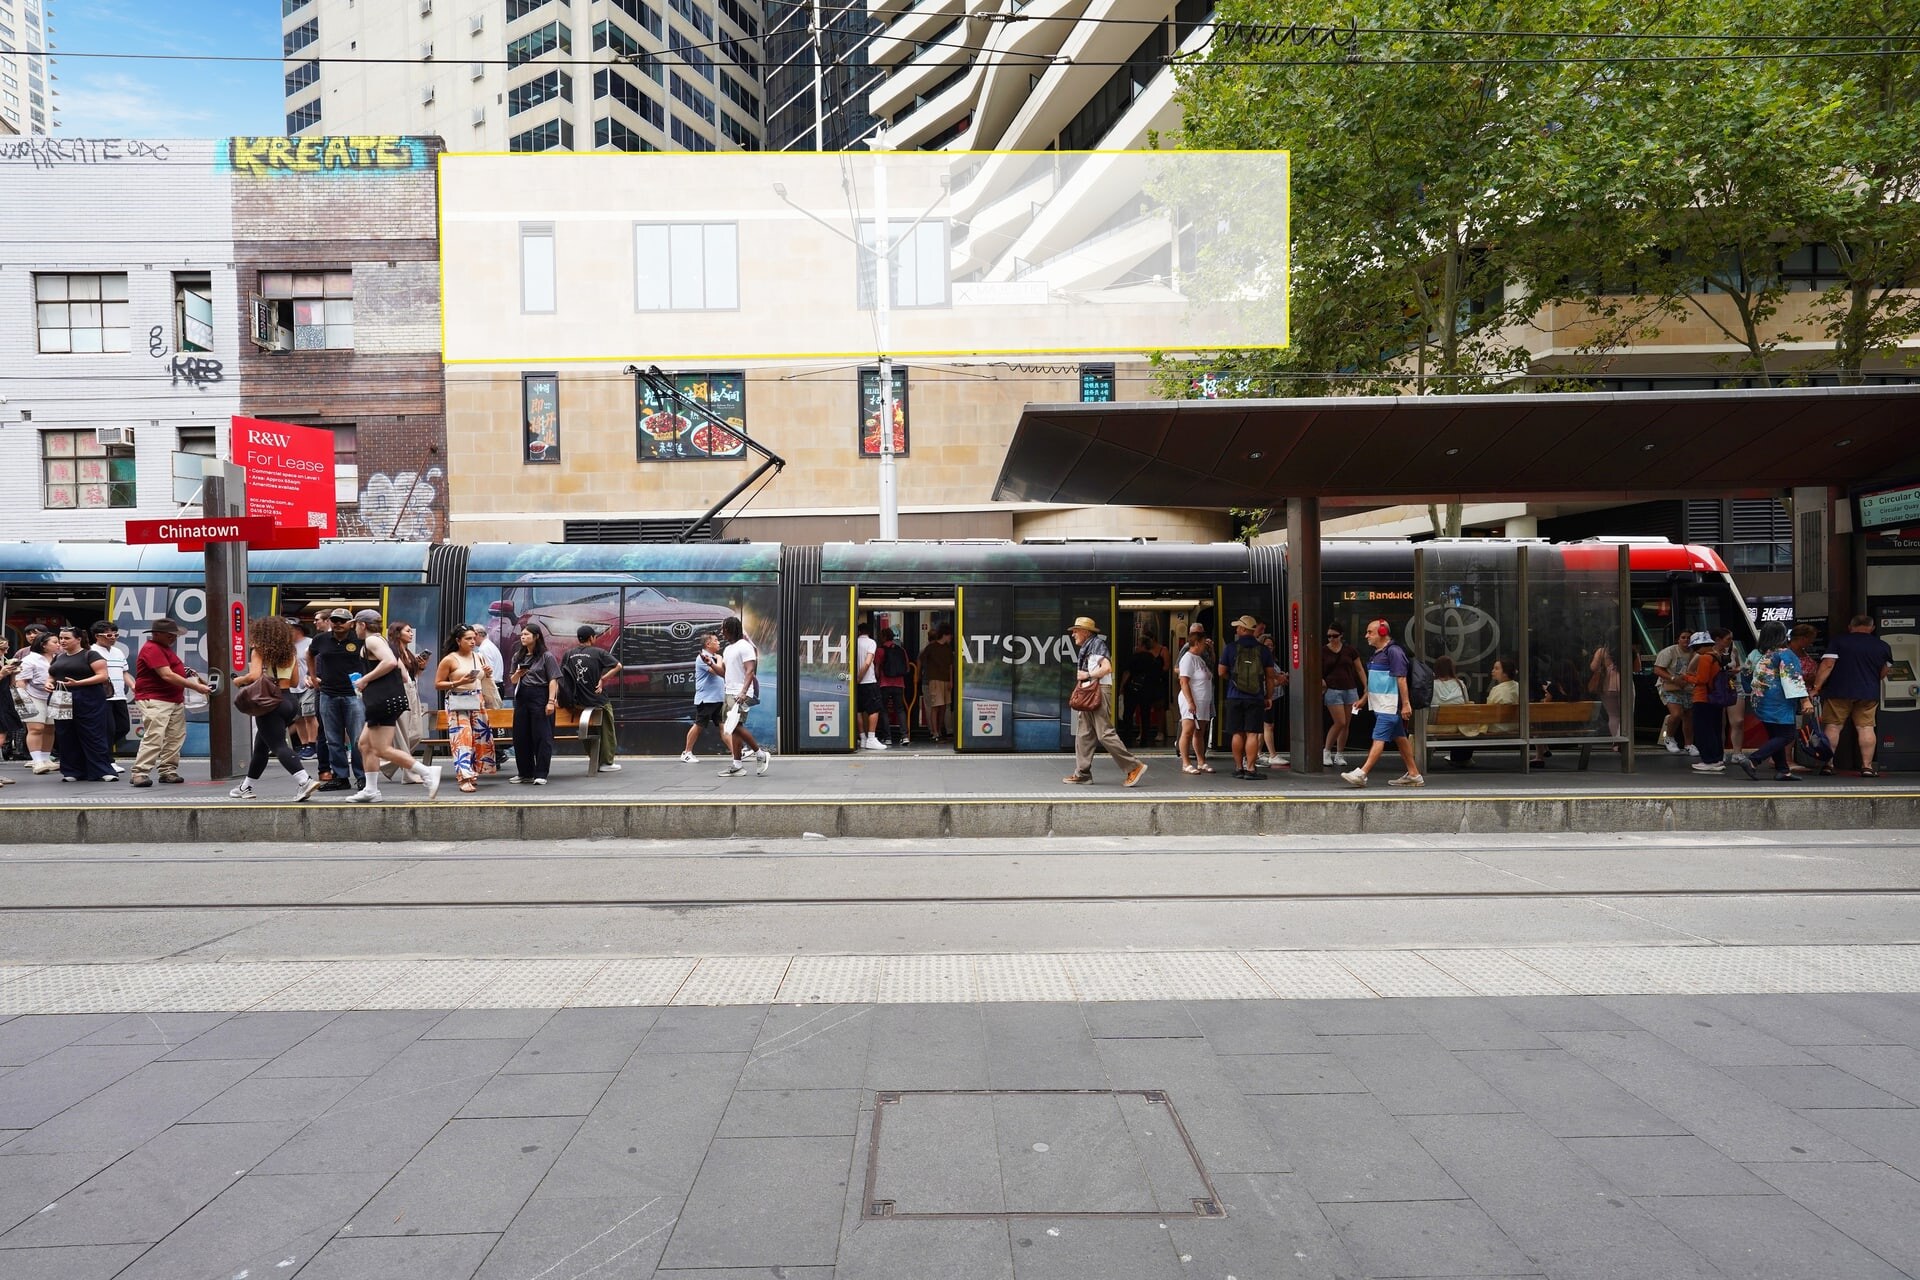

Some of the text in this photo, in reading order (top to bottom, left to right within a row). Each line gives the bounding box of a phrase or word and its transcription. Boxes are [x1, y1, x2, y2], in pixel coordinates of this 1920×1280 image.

[230, 135, 412, 177] KREATE
[247, 429, 291, 448] R&W
[247, 450, 324, 473] For Lease
[1863, 500, 1873, 508] L3
[1879, 494, 1912, 505] Circular
[1880, 506, 1902, 514] Circular
[158, 524, 239, 539] Chinatown
[1344, 591, 1414, 600] L2 Randwick
[666, 674, 685, 684] YOS
